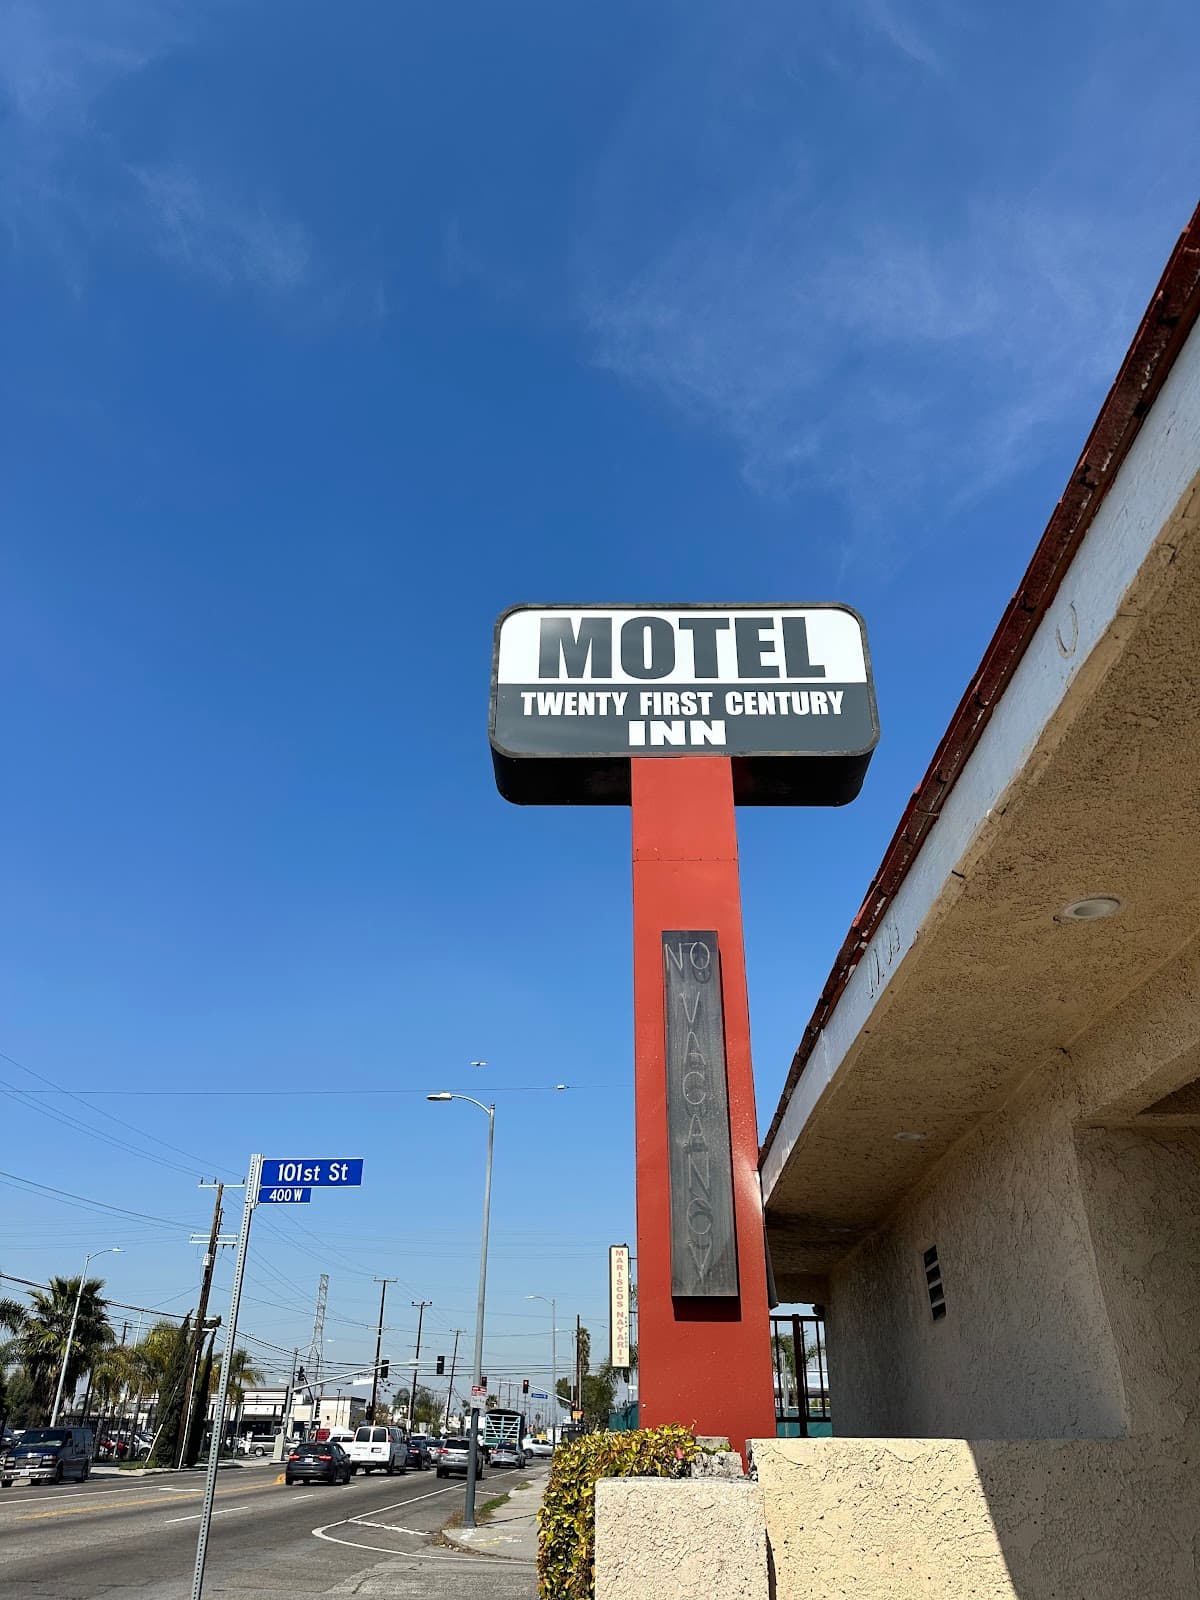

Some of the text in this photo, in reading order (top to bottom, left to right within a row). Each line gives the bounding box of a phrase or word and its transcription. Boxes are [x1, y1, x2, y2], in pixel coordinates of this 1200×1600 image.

[538, 616, 826, 680] MOTEL
[520, 690, 844, 716] TWENTY FIRST CENTURY
[628, 719, 727, 746] INN
[665, 942, 710, 971] NO
[680, 991, 713, 1281] VACANCY
[278, 1163, 348, 1181] 101st St
[269, 1189, 303, 1201] 400 W
[615, 1250, 624, 1364] MARISCOS NAYARIT
